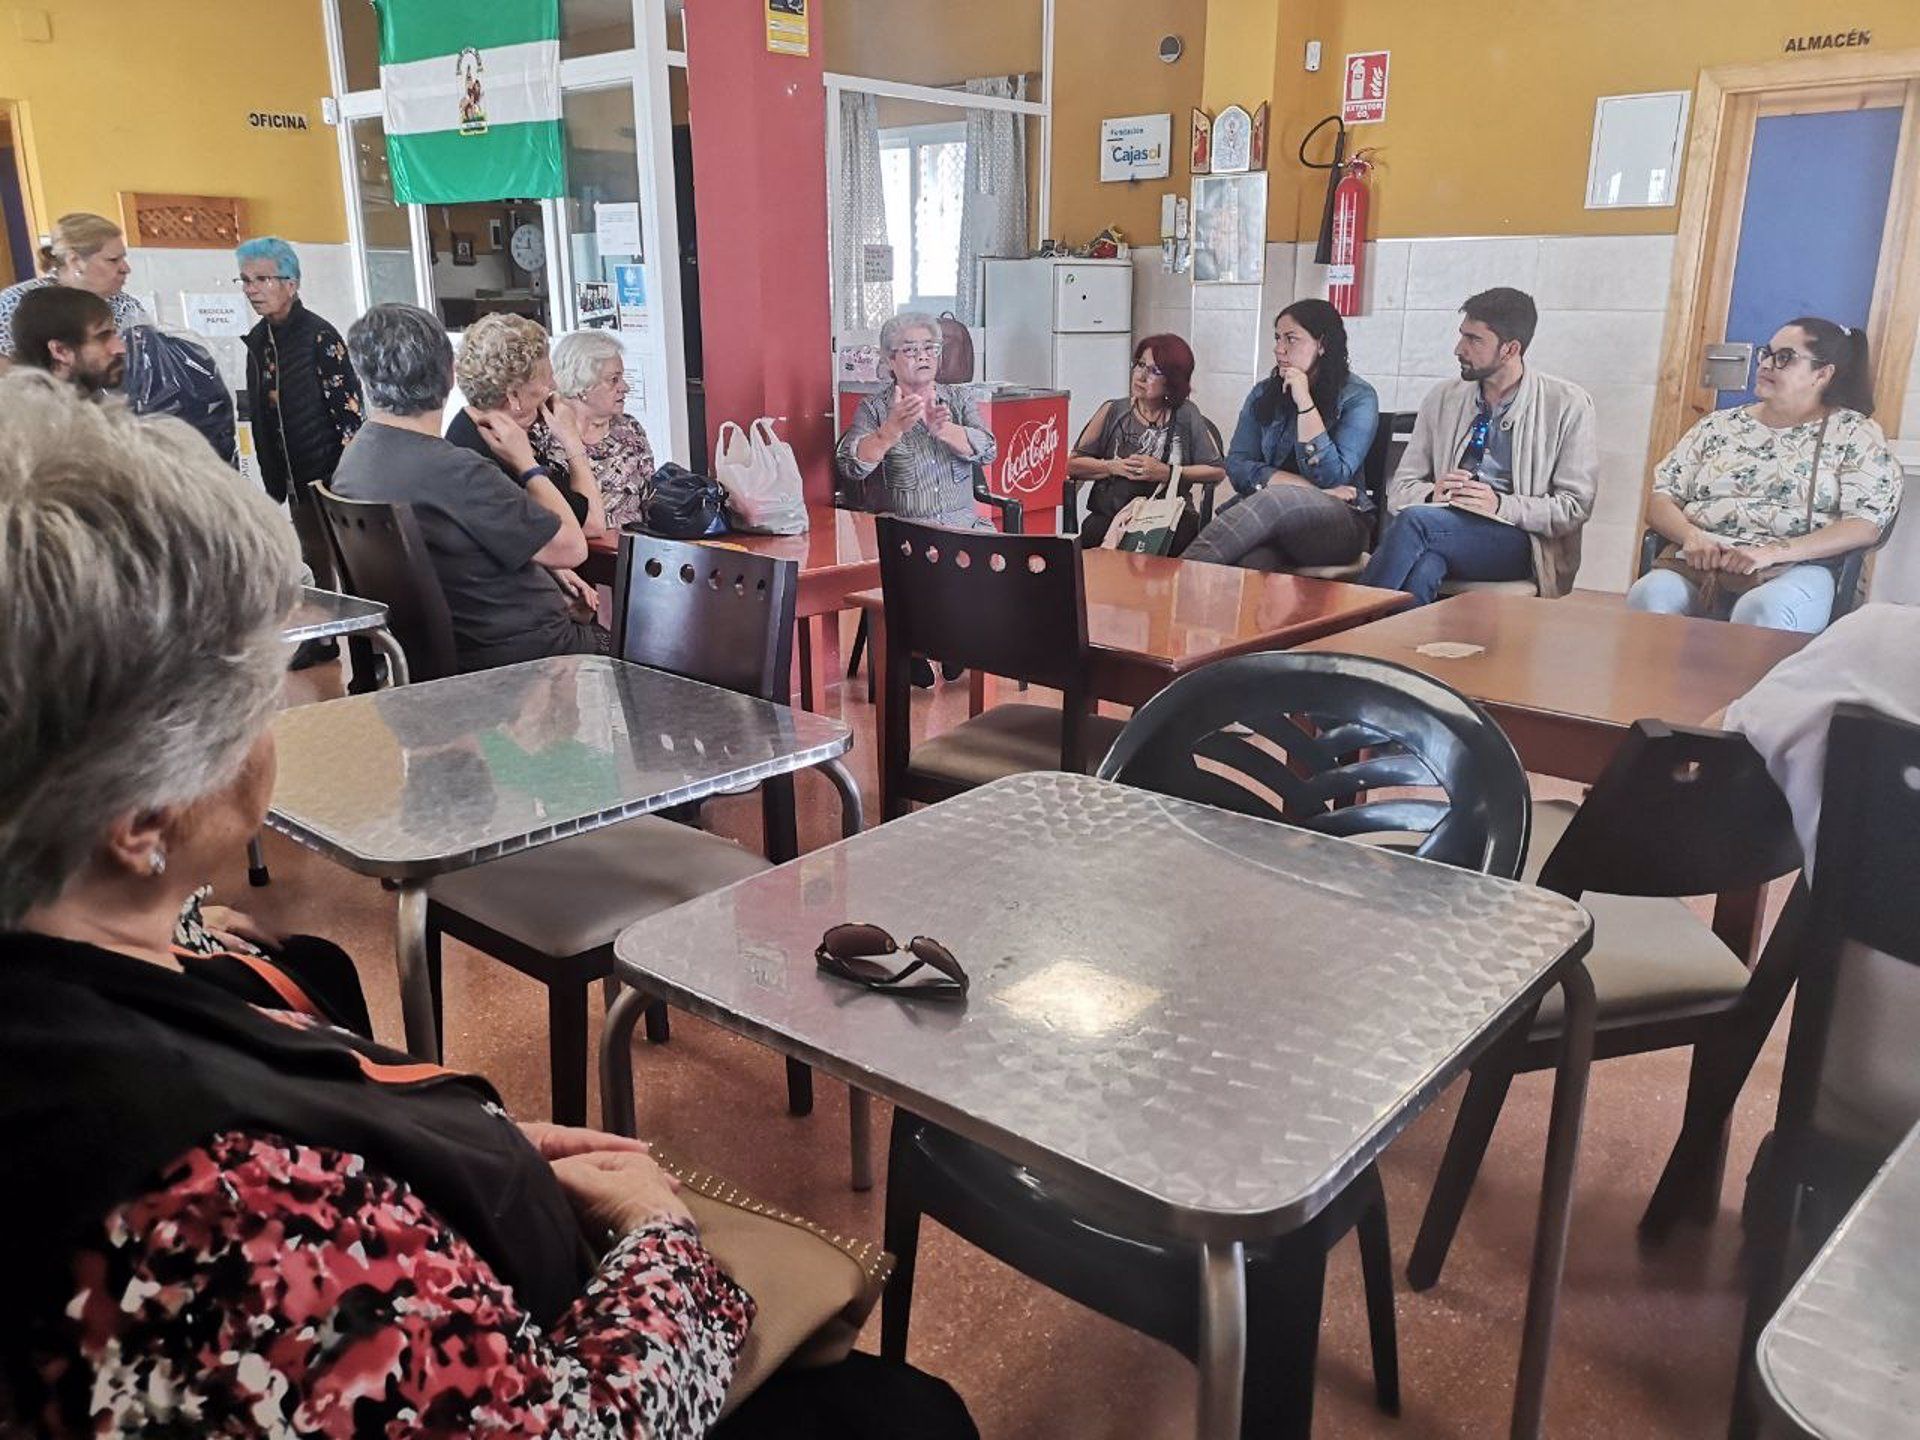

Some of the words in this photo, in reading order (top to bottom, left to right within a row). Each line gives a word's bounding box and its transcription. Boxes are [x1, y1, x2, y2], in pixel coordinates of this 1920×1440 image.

[1785, 28, 1871, 52] ALMACÉN
[1346, 102, 1383, 113] EXTINTOR
[249, 113, 307, 130] OFICINA
[1112, 143, 1161, 166] Cajasol
